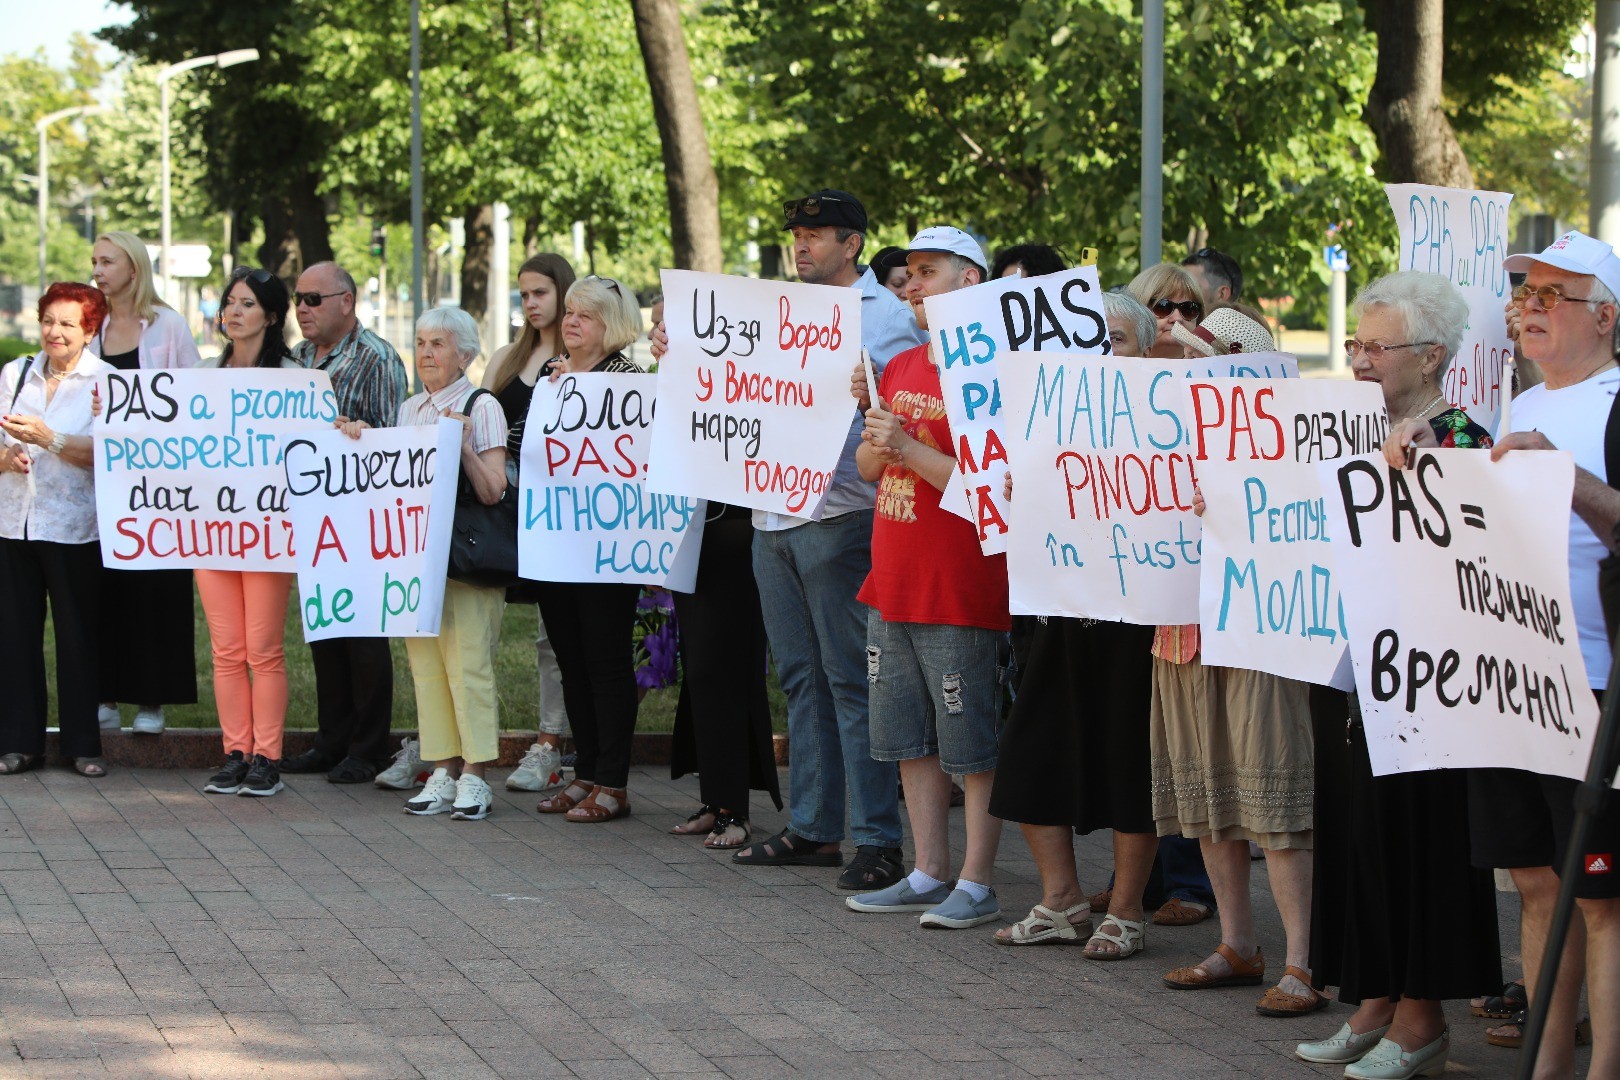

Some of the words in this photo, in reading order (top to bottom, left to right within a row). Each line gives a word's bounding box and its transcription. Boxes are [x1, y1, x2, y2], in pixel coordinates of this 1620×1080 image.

[693, 288, 761, 357] Из-за
[105, 372, 179, 424] PAS
[190, 394, 215, 420] a
[231, 381, 338, 436] promis
[543, 377, 657, 434] Вла
[891, 390, 945, 411] TENACIOU
[1025, 363, 1139, 449] MAIA
[1189, 383, 1285, 461] PAS
[691, 411, 762, 462] народ
[129, 476, 199, 512] dar
[216, 485, 246, 513] a
[1337, 453, 1451, 548] PAS
[312, 515, 348, 567] A
[1046, 532, 1084, 567] în
[1109, 521, 1201, 596] fust
[305, 583, 356, 631] de
